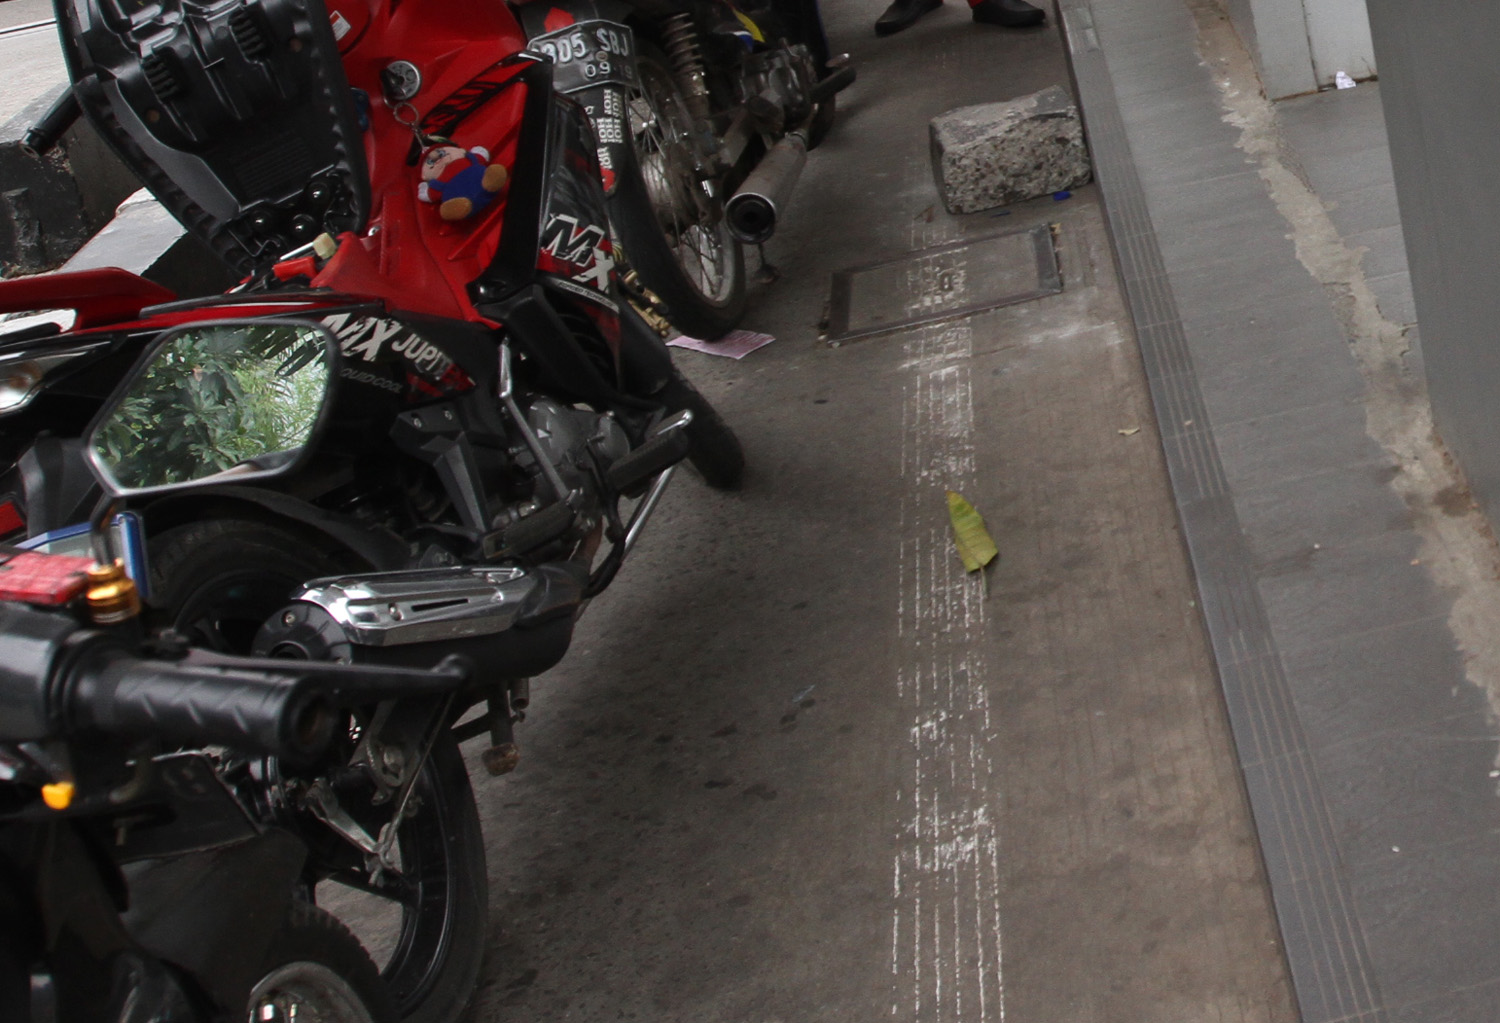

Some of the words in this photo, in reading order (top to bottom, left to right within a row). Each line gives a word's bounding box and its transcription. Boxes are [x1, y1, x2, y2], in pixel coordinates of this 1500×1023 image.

[596, 28, 630, 57] SBJ
[541, 213, 615, 294] MX
[320, 312, 403, 363] MX
